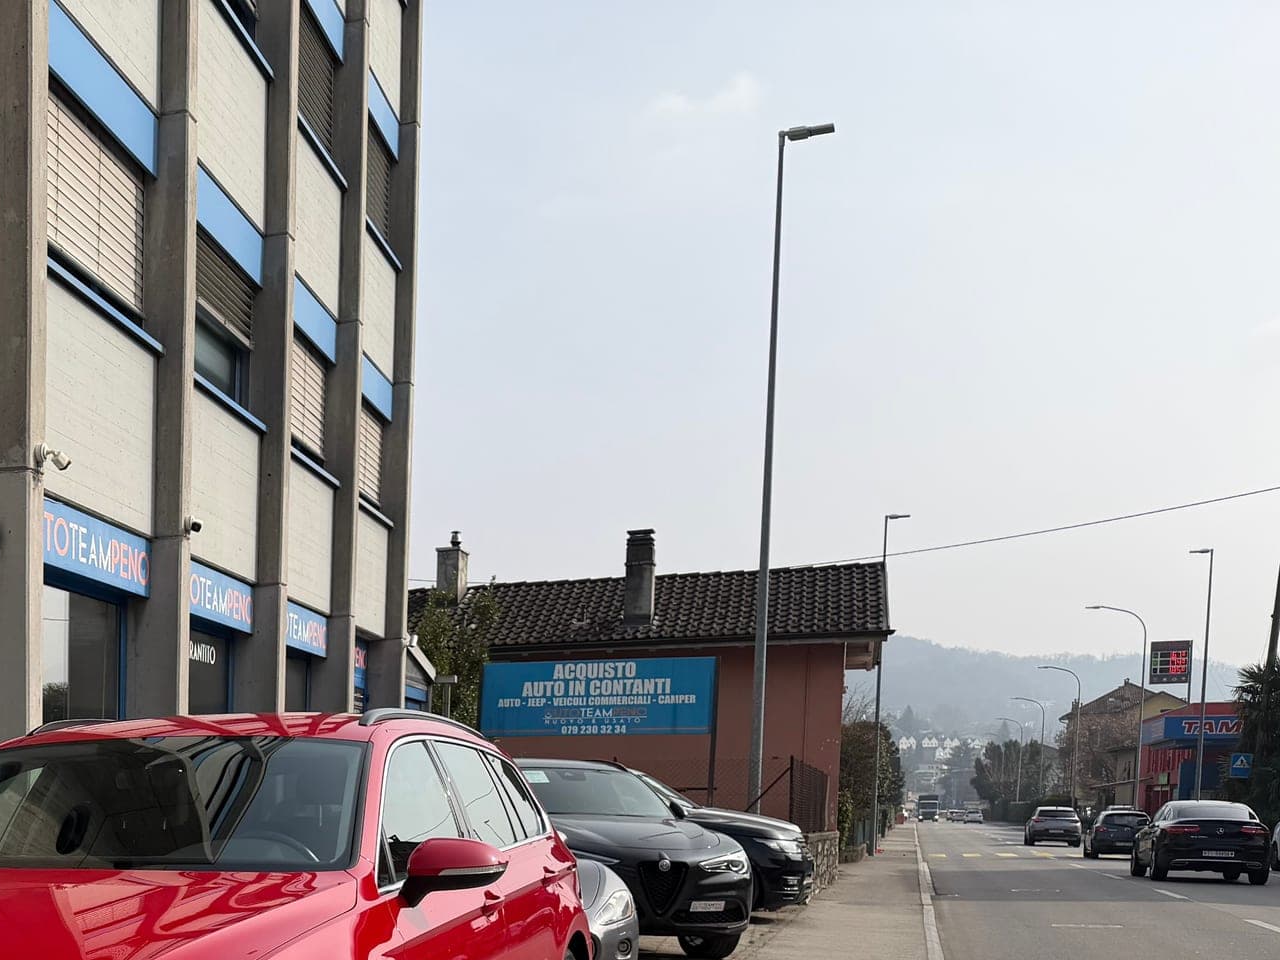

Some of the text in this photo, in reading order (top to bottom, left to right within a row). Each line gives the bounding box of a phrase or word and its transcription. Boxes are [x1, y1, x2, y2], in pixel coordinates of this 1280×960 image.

[553, 662, 637, 680] ACQUISTO
[522, 678, 671, 697] AUTO IN CONTANTI
[498, 699, 521, 708] AUTO
[527, 698, 546, 707] JEEP
[553, 697, 586, 706] VEICOLI
[588, 695, 651, 705] COMMERCIALI
[658, 694, 696, 705] CAMPER
[561, 725, 627, 735] 079 230 32 34
